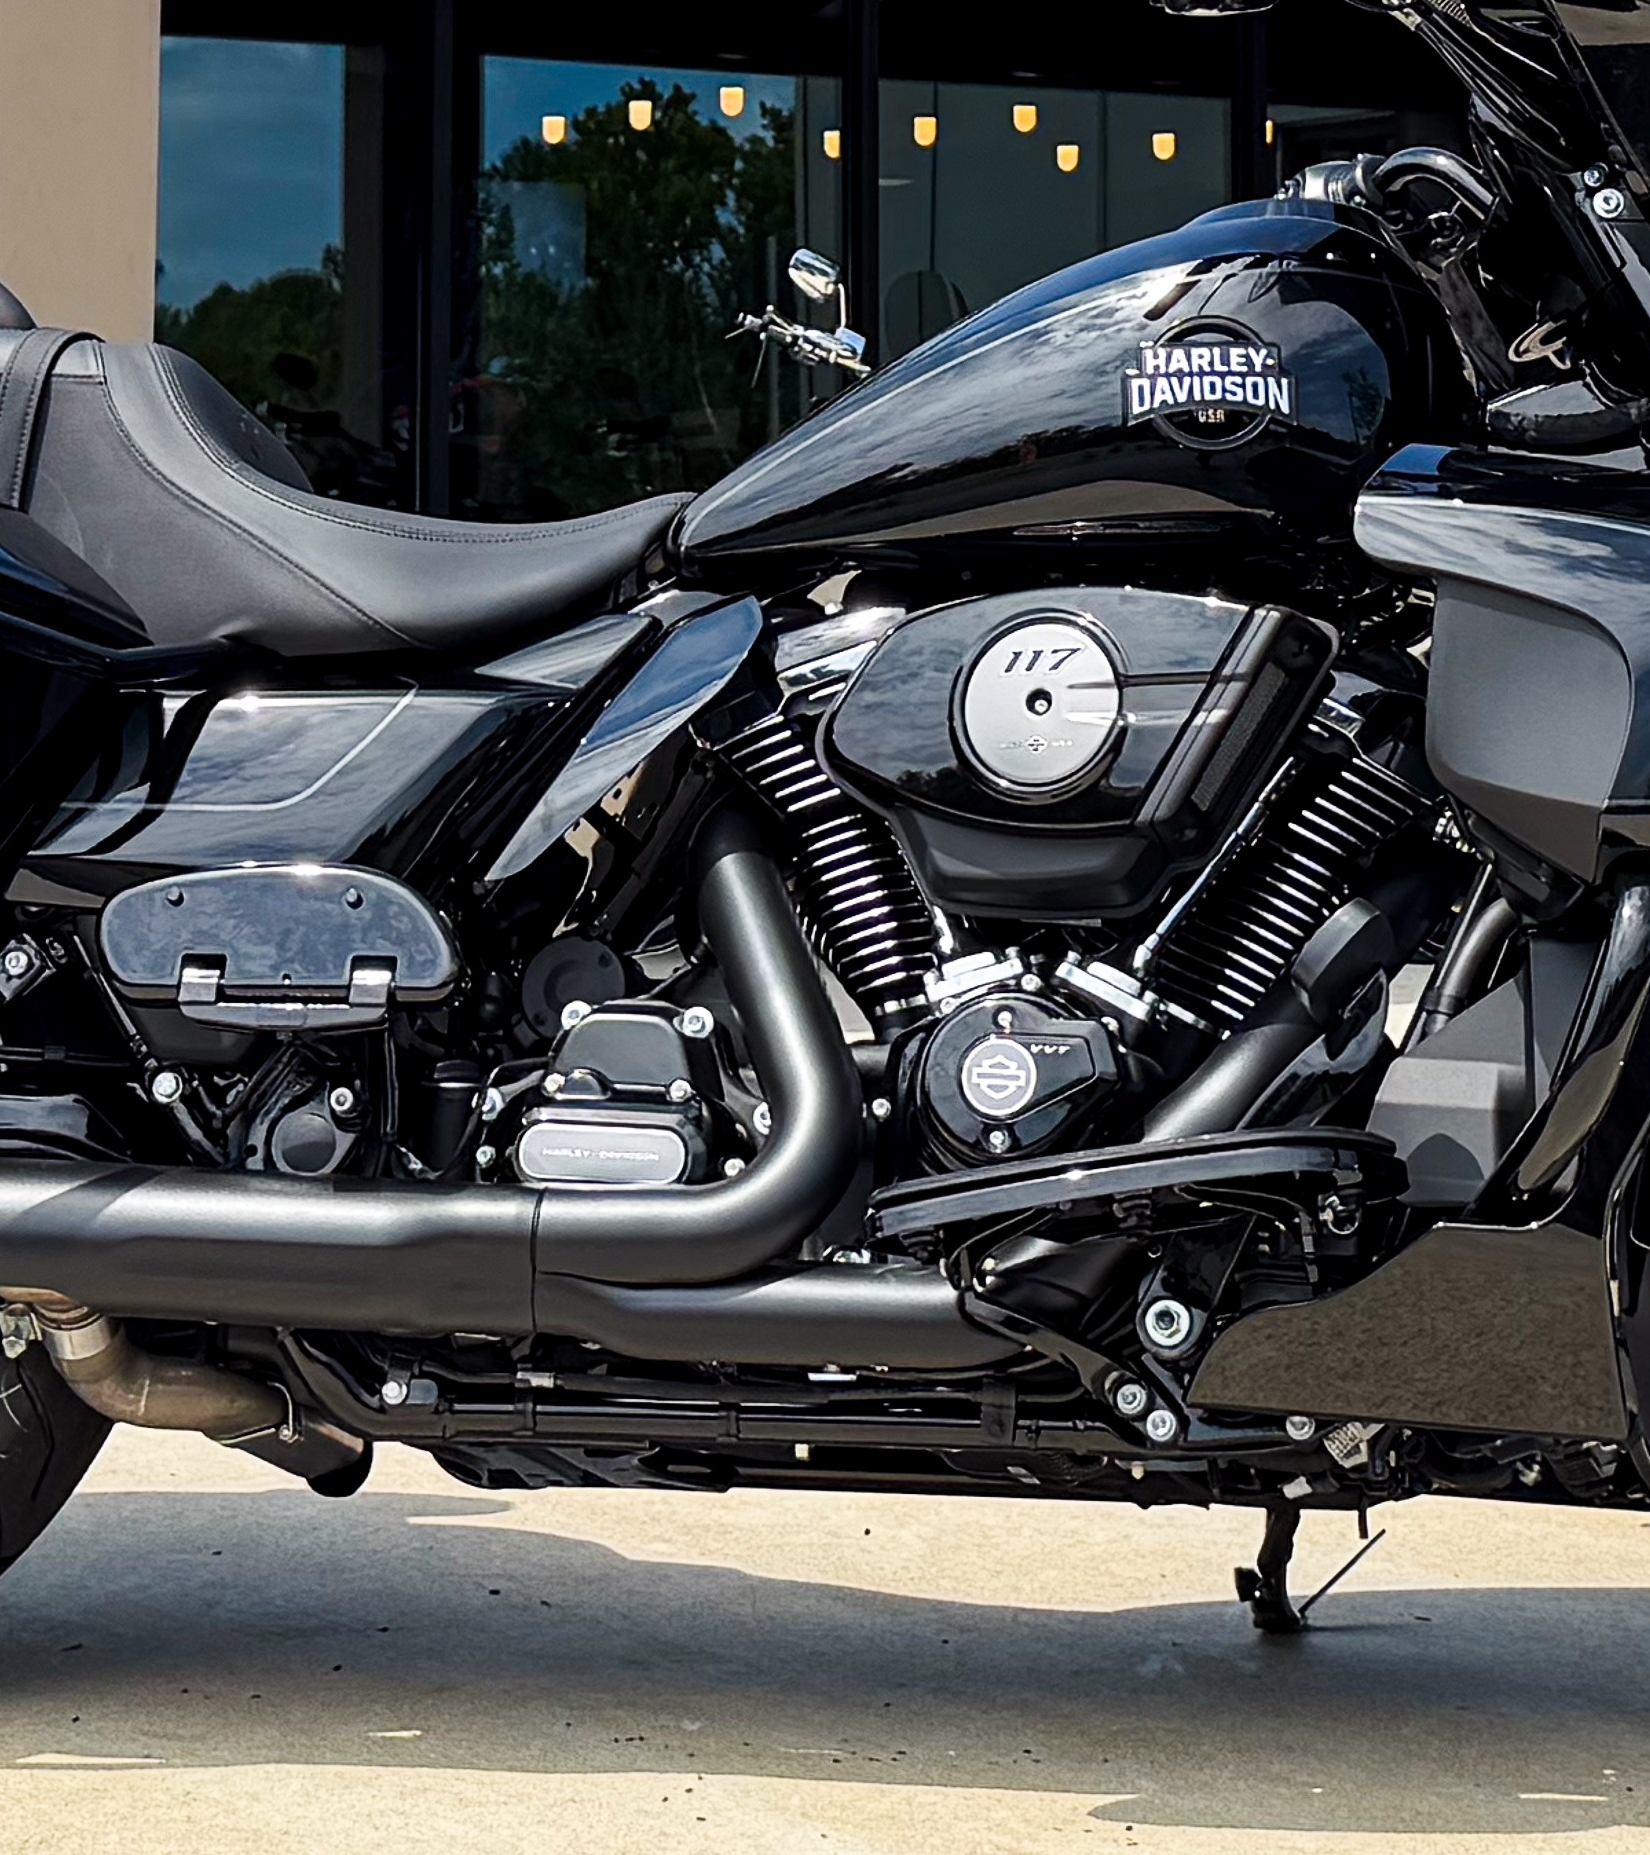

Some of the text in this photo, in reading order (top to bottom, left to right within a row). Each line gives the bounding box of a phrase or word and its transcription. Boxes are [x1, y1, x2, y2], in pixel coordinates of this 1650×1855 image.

[1143, 346, 1277, 375] HARLEY-
[1130, 375, 1291, 416] DAVIDSON
[1002, 647, 1084, 674] 117
